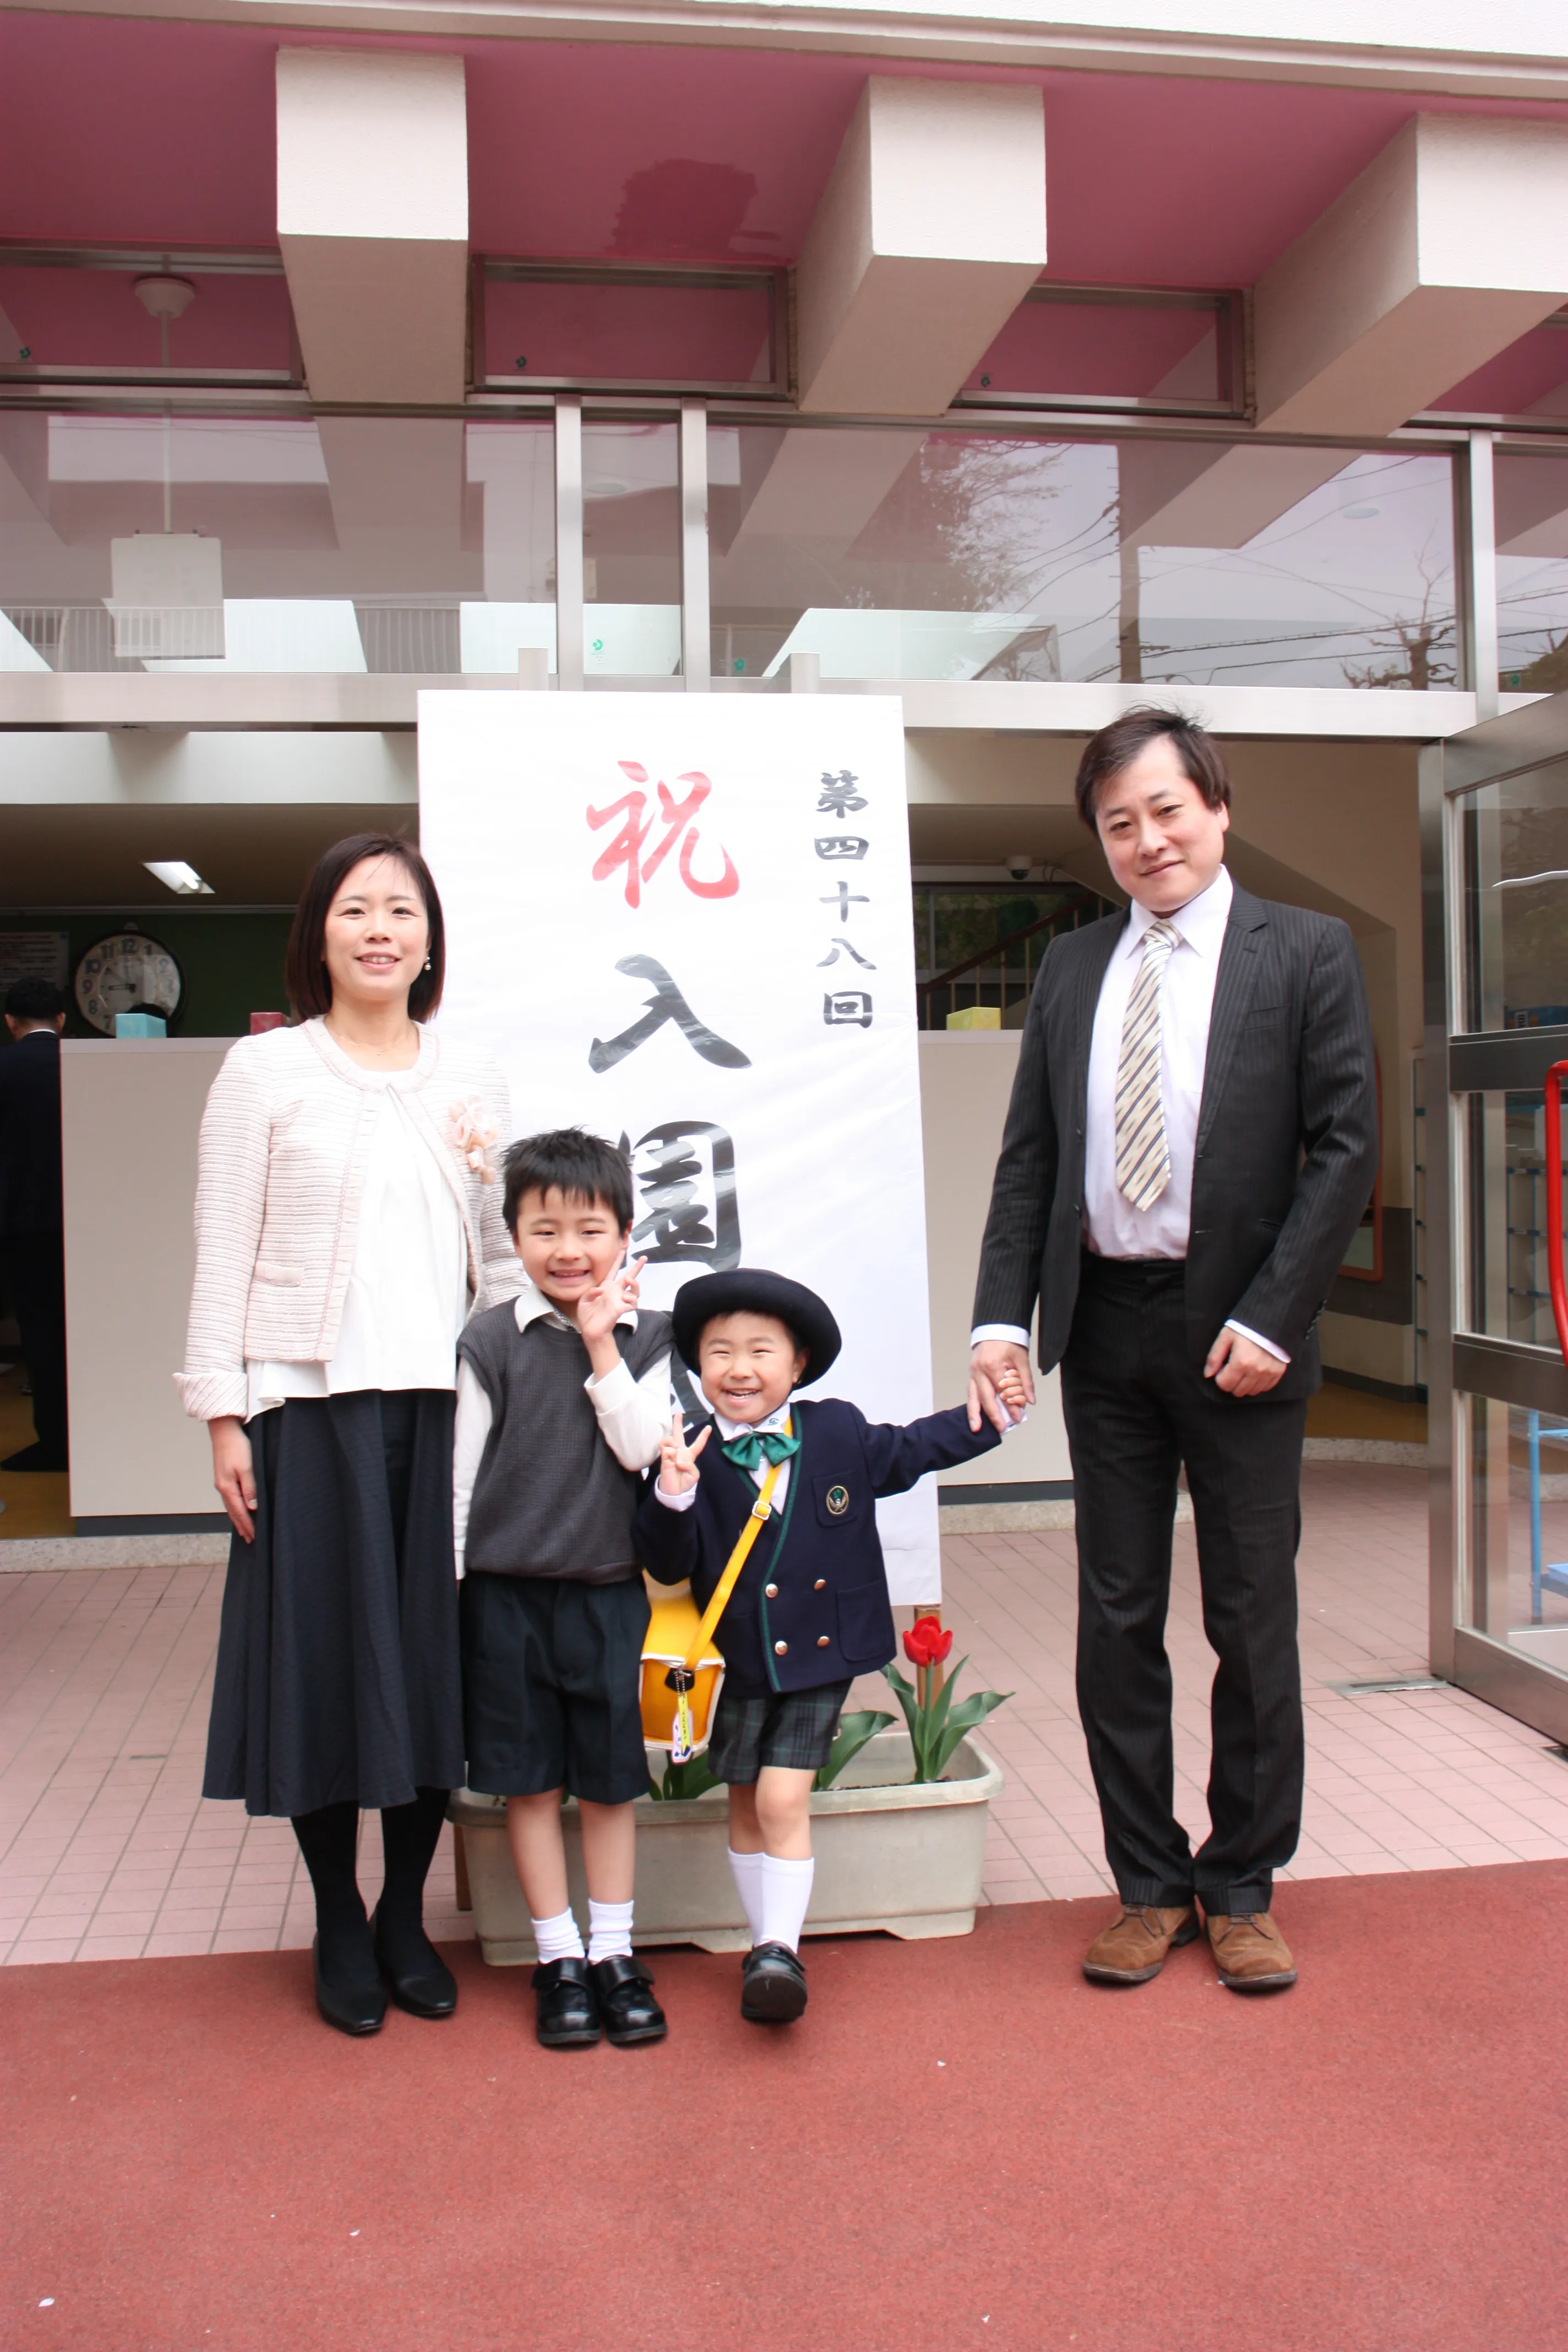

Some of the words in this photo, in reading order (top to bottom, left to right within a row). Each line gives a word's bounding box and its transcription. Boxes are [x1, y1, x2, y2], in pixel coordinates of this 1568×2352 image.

[815, 770, 877, 1028] 第四十八回
[100, 943, 114, 959] 11
[122, 938, 135, 954] 12
[144, 943, 153, 956] 1
[85, 959, 101, 974] 10
[159, 958, 172, 974] 2
[83, 978, 93, 994] 9
[88, 999, 98, 1014] 8
[103, 1014, 113, 1030] 7
